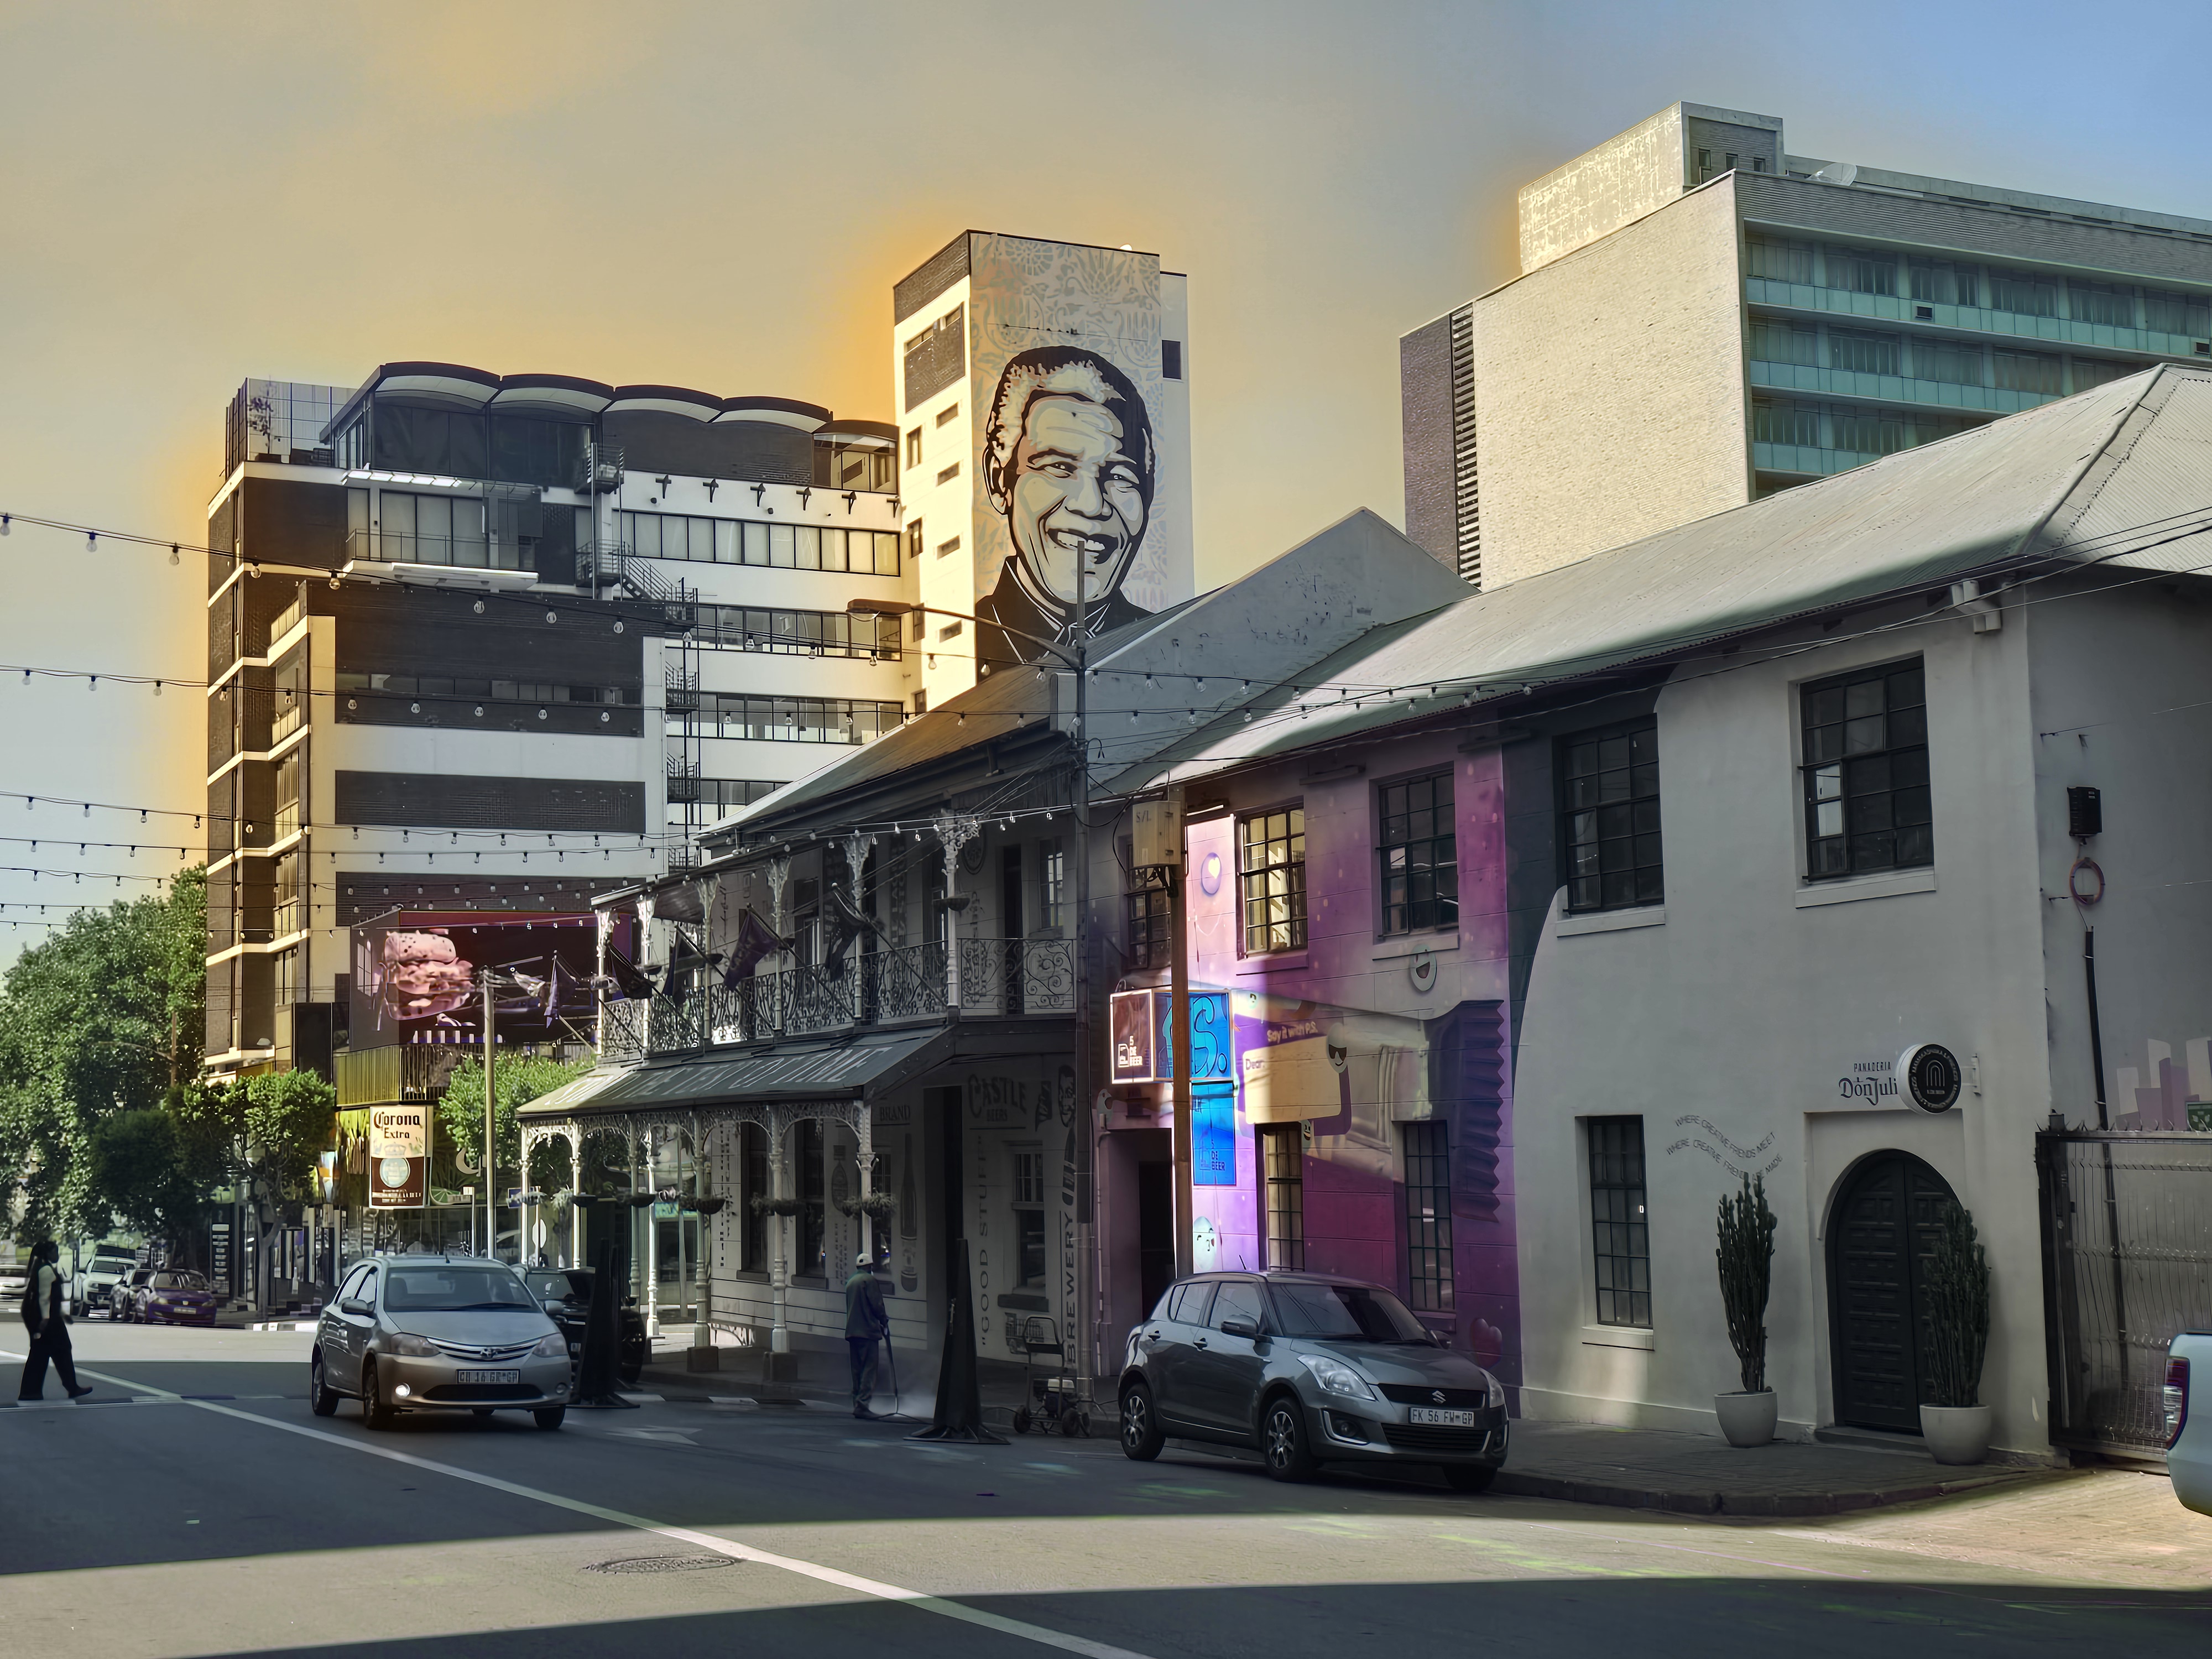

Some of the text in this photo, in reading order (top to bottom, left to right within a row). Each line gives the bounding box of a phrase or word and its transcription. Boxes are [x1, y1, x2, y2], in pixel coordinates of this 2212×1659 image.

[1267, 1030, 1281, 1044] Say
[1129, 1046, 1137, 1056] DE
[661, 1059, 763, 1097] TEST
[728, 1055, 806, 1089] OF
[769, 1046, 893, 1086] TIME
[1854, 1061, 1891, 1072] PANADERIA
[967, 1073, 1027, 1119] CASTLE
[373, 1111, 422, 1130] Corona
[986, 1108, 1008, 1122] BEERS
[384, 1127, 410, 1139] Extra
[1674, 1114, 1776, 1159] WHERE CREATIVE FRIENDS MEET
[1666, 1138, 1689, 1156] WHERE
[1693, 1139, 1721, 1164] CREATIVE
[1765, 1153, 1783, 1175] MADE
[1211, 1161, 1225, 1171] BEER
[1063, 1211, 1076, 1365] BREWERY
[1412, 1409, 1423, 1422] FK
[1428, 1410, 1439, 1423] 56
